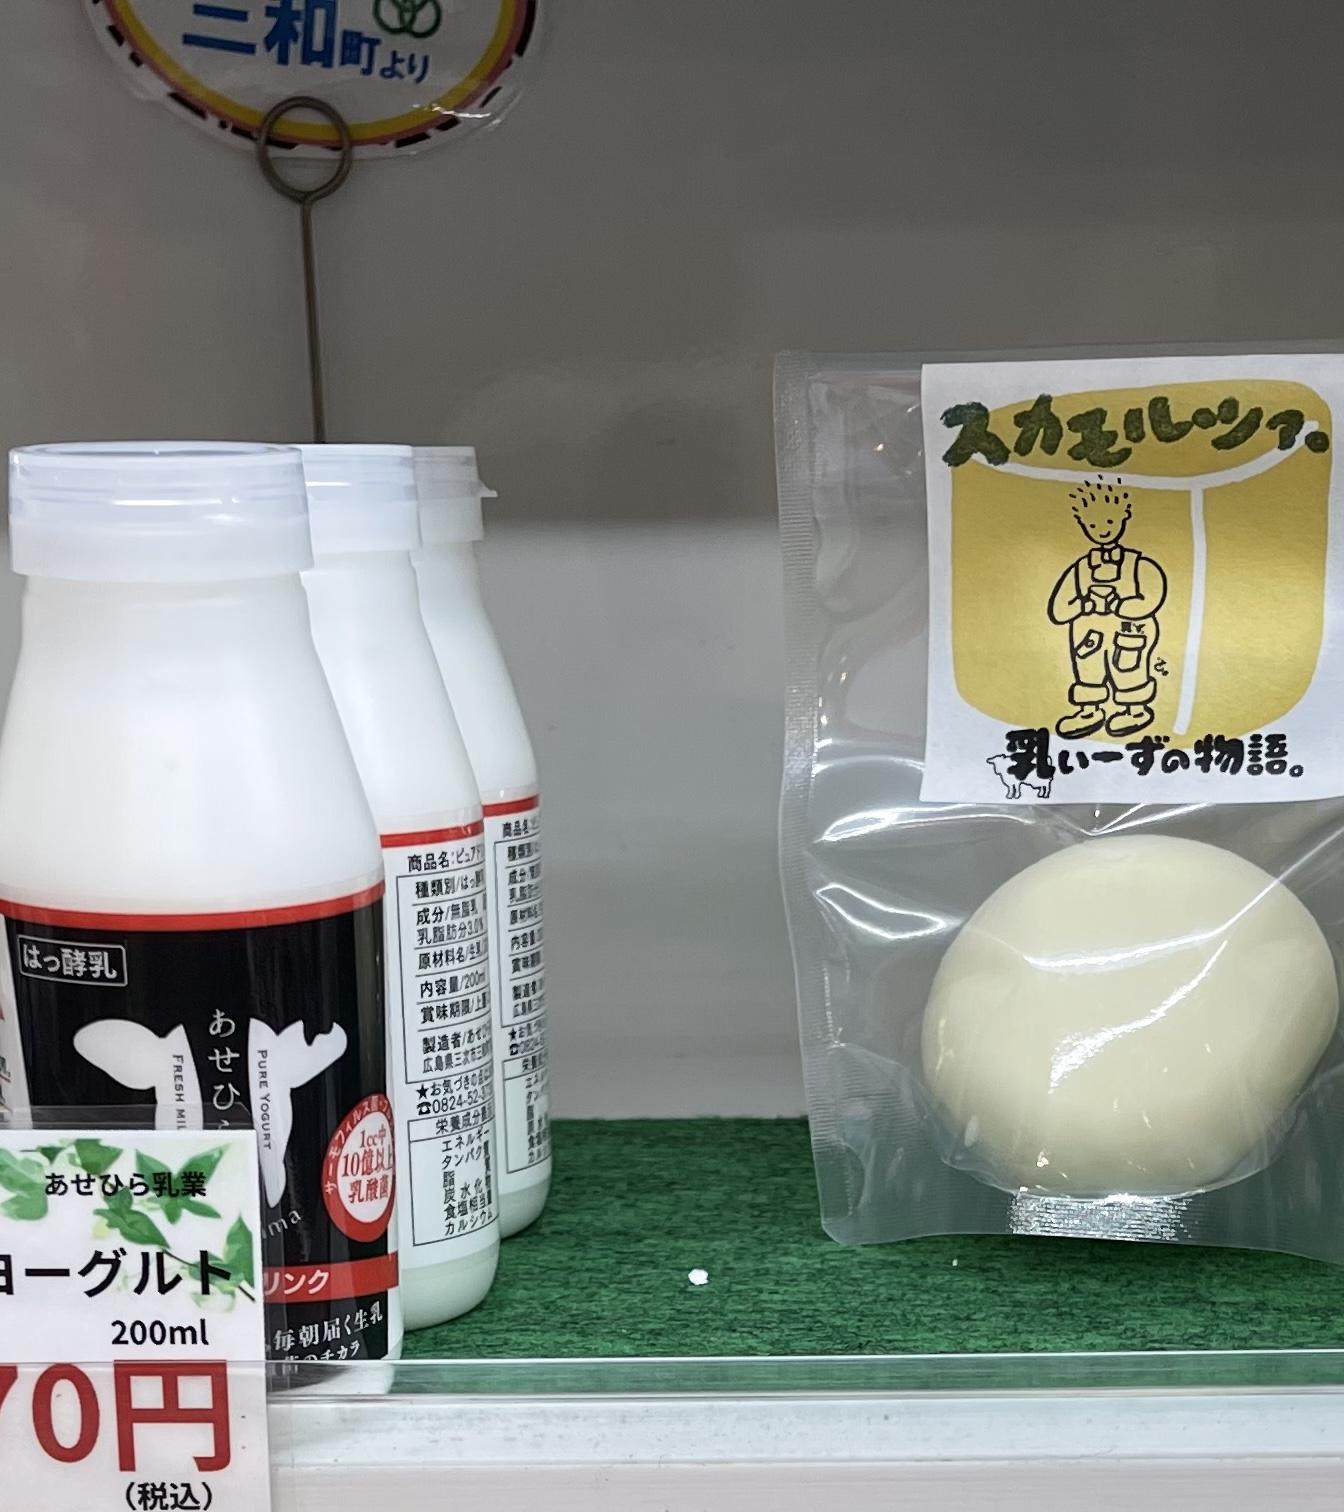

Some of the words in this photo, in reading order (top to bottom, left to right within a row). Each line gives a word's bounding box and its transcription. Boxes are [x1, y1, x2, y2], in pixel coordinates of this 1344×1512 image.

[22, 943, 117, 979] はっ酵乳
[173, 1055, 186, 1103] FRESH
[208, 1009, 241, 1128] あせひ
[257, 1050, 269, 1089] PURE
[45, 1171, 207, 1198] あせひら乳業
[111, 1319, 209, 1346] 200ml
